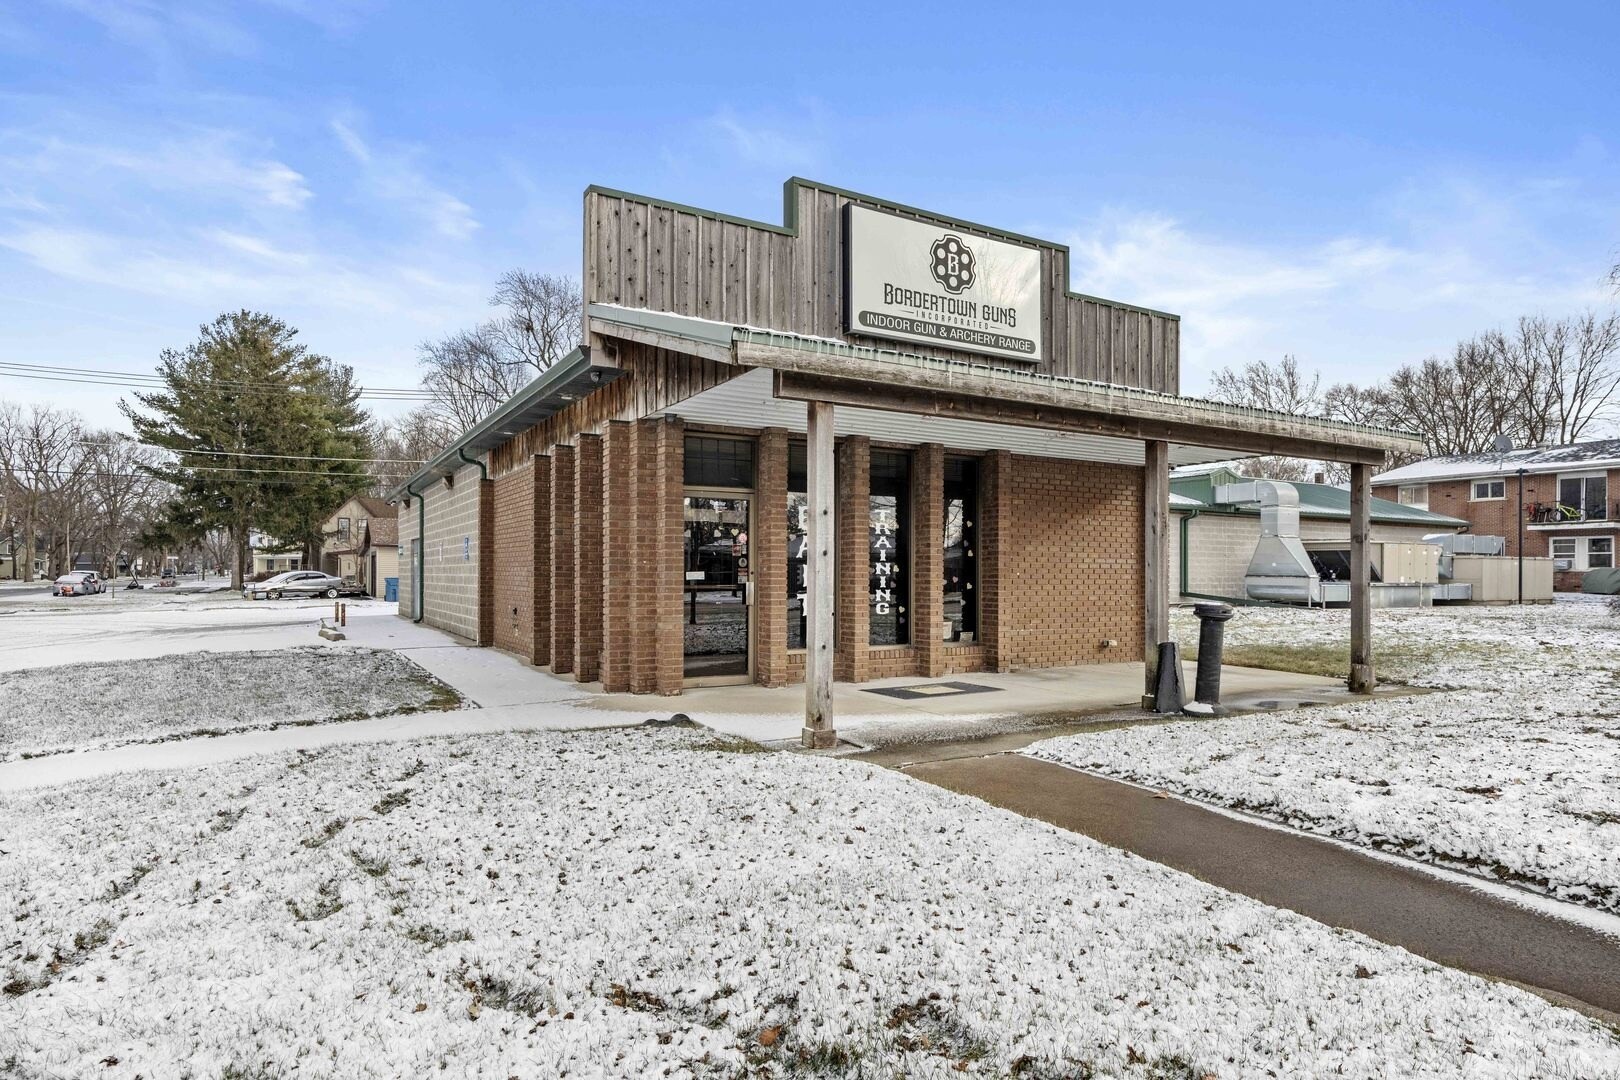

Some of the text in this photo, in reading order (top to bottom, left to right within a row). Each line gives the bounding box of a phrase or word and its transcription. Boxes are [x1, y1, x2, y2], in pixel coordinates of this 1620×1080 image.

[947, 253, 960, 276] B
[883, 283, 1016, 328] BORDERTOWN GUNS
[916, 310, 988, 330] INCORPORATED
[866, 313, 1031, 351] INDOOR GUN & ARCHERY RANGE
[874, 509, 892, 615] TRAINING
